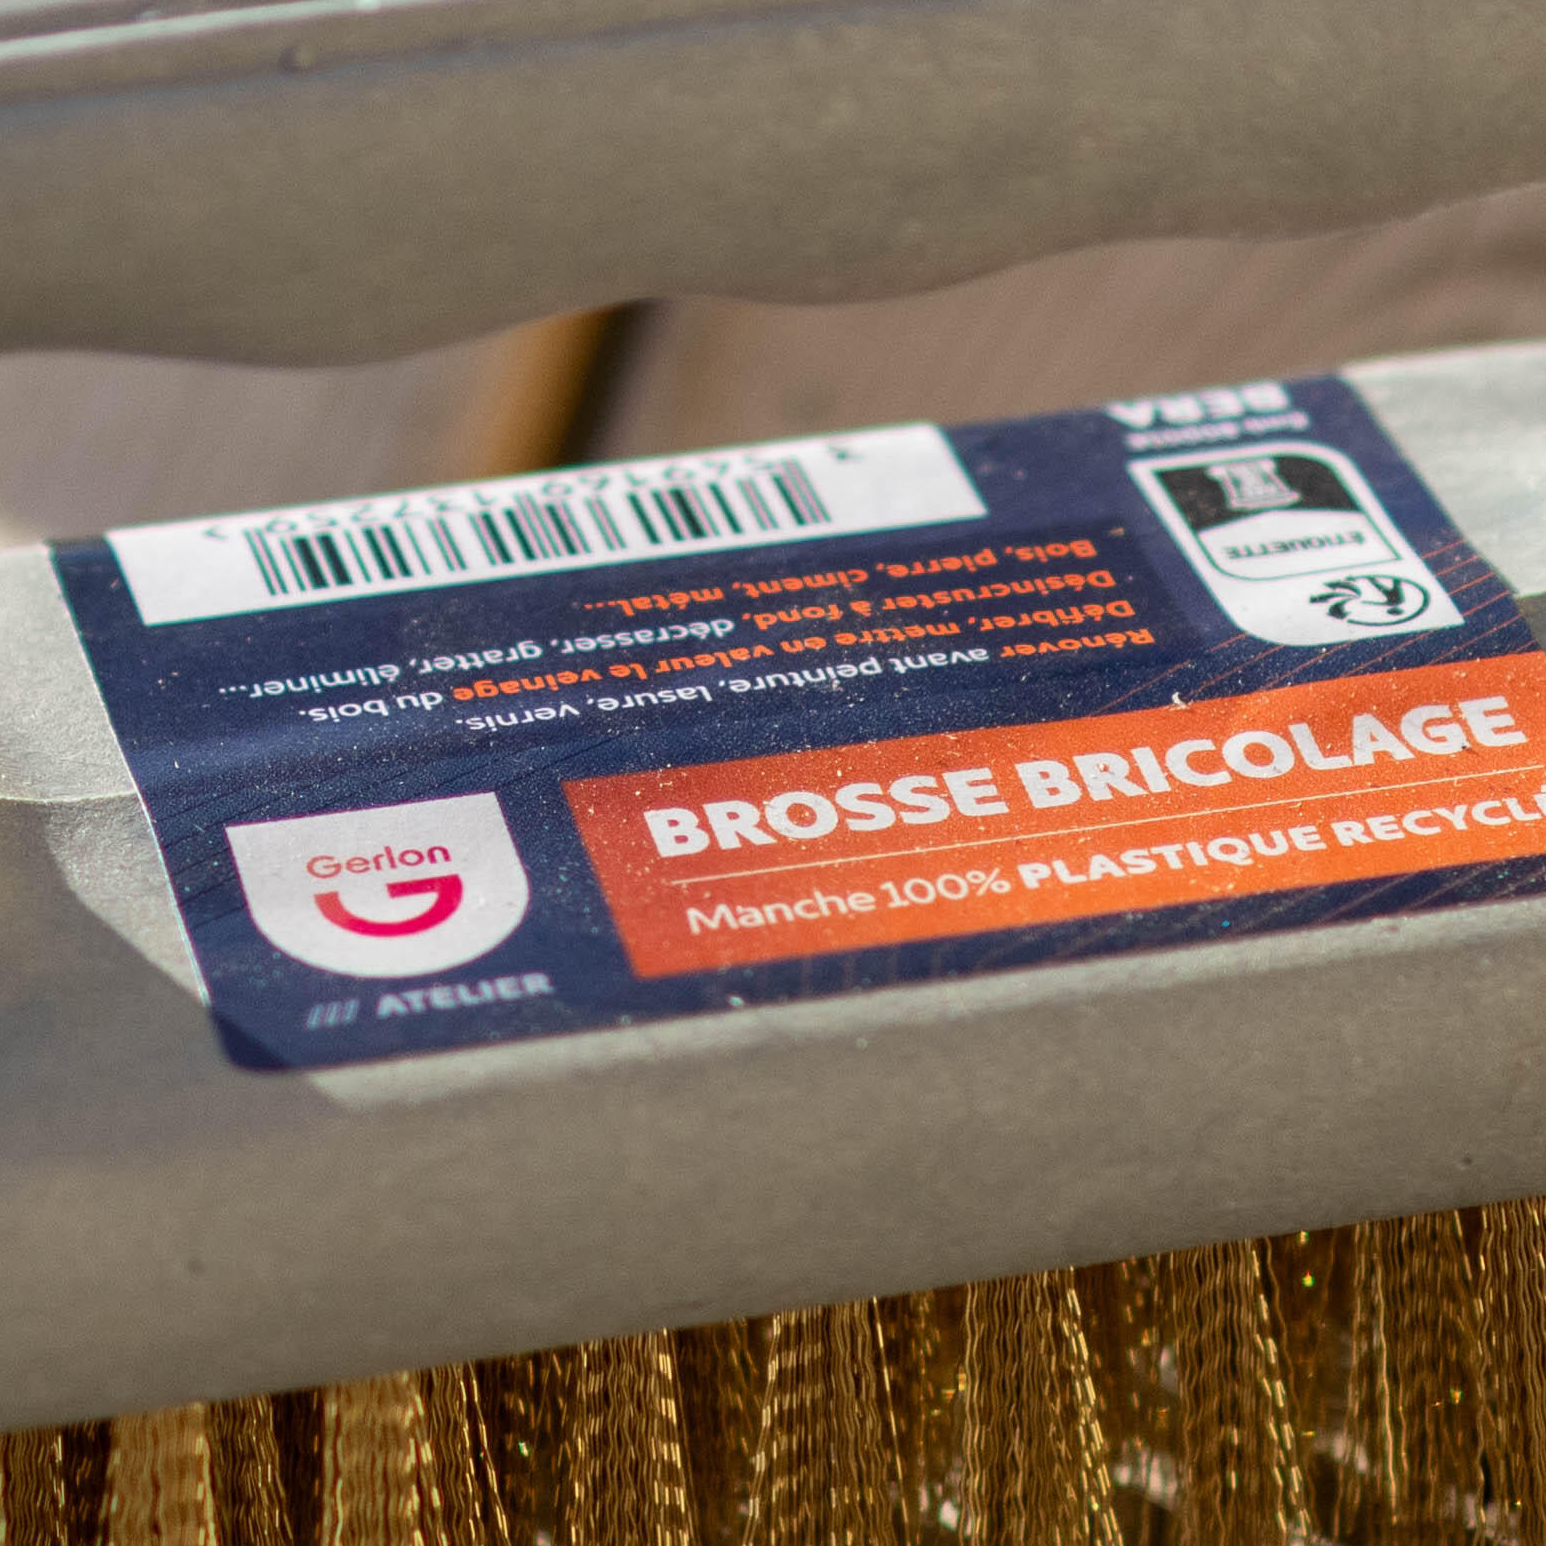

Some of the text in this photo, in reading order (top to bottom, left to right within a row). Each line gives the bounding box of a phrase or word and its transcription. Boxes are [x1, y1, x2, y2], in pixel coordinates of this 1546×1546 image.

[876, 547, 998, 578] pierre,
[1005, 539, 1098, 563] Bois,
[1224, 531, 1366, 560] ÉTIQUETTE
[732, 567, 869, 598] ciment,
[881, 569, 1117, 611] Désincruster
[742, 603, 845, 630] fond,
[850, 599, 872, 616] à
[550, 618, 735, 655] décrasser,
[299, 600, 1136, 722] Défibrer, mettre en valeur le veinage du bois.
[409, 639, 543, 675] gratter,
[454, 628, 1156, 732] Rénover avant peinture, lasure, vernis.
[643, 695, 1528, 858] BROSSE BRICOLAGE
[306, 845, 452, 879] Gerlon
[685, 887, 876, 935] Manche
[879, 866, 1012, 909] 100%
[1017, 824, 1328, 890] PLASTIQUE
[375, 972, 555, 1020] ATELIER
